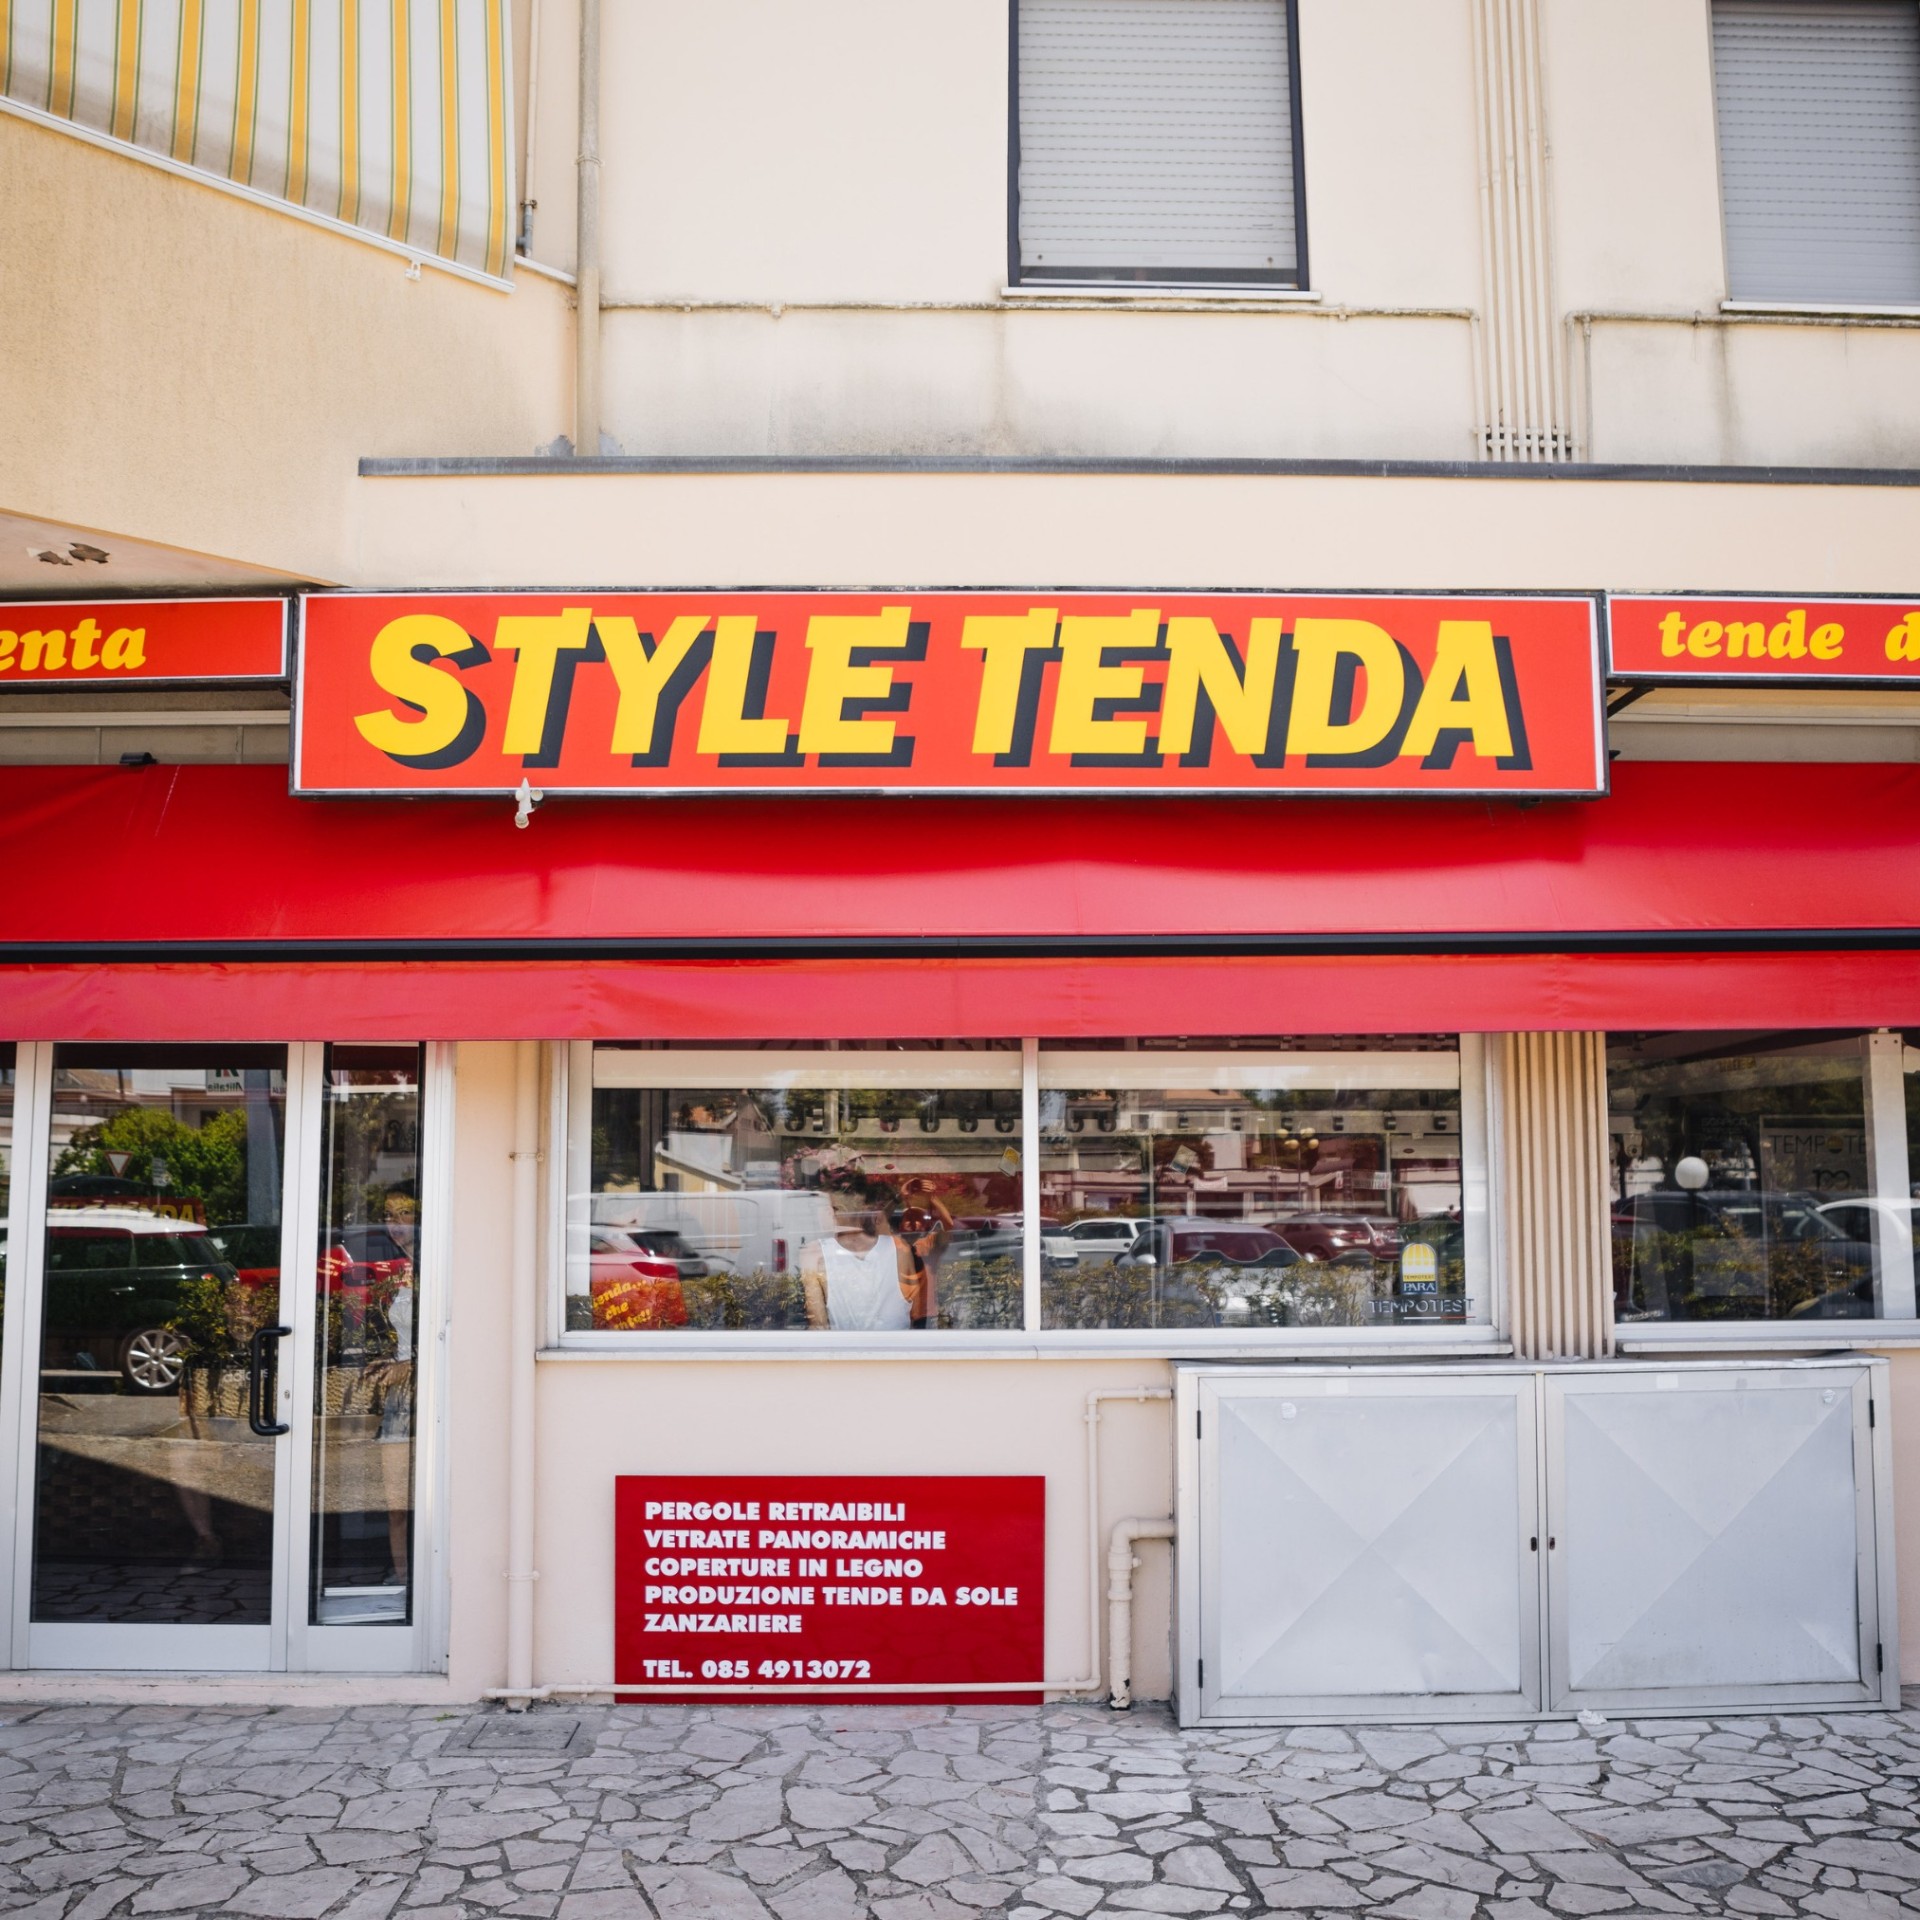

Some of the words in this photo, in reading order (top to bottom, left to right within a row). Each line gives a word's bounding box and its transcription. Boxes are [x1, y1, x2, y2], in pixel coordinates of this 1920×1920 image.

[1658, 609, 1845, 660] tende
[354, 606, 924, 769] STYLE
[960, 607, 1530, 770] TENDA
[1367, 1299, 1475, 1313] TEMPOTEST
[645, 1501, 761, 1521] PERGOLE
[768, 1502, 906, 1522] RETRAIBILI
[643, 1529, 751, 1549] VETRATE
[758, 1530, 946, 1550] PANORAMICHE
[644, 1557, 791, 1577] COPERTURE
[798, 1558, 828, 1577] IN
[836, 1558, 924, 1578] LEGNO
[645, 1585, 815, 1606] PRODUZIONE
[821, 1586, 903, 1606] TENDE
[910, 1586, 948, 1606] DA
[955, 1586, 1018, 1606] SOLE
[643, 1613, 802, 1633] ZANZARIERE
[642, 1659, 694, 1679] TEL.
[701, 1659, 750, 1679] 085
[757, 1659, 871, 1679] 4913072
